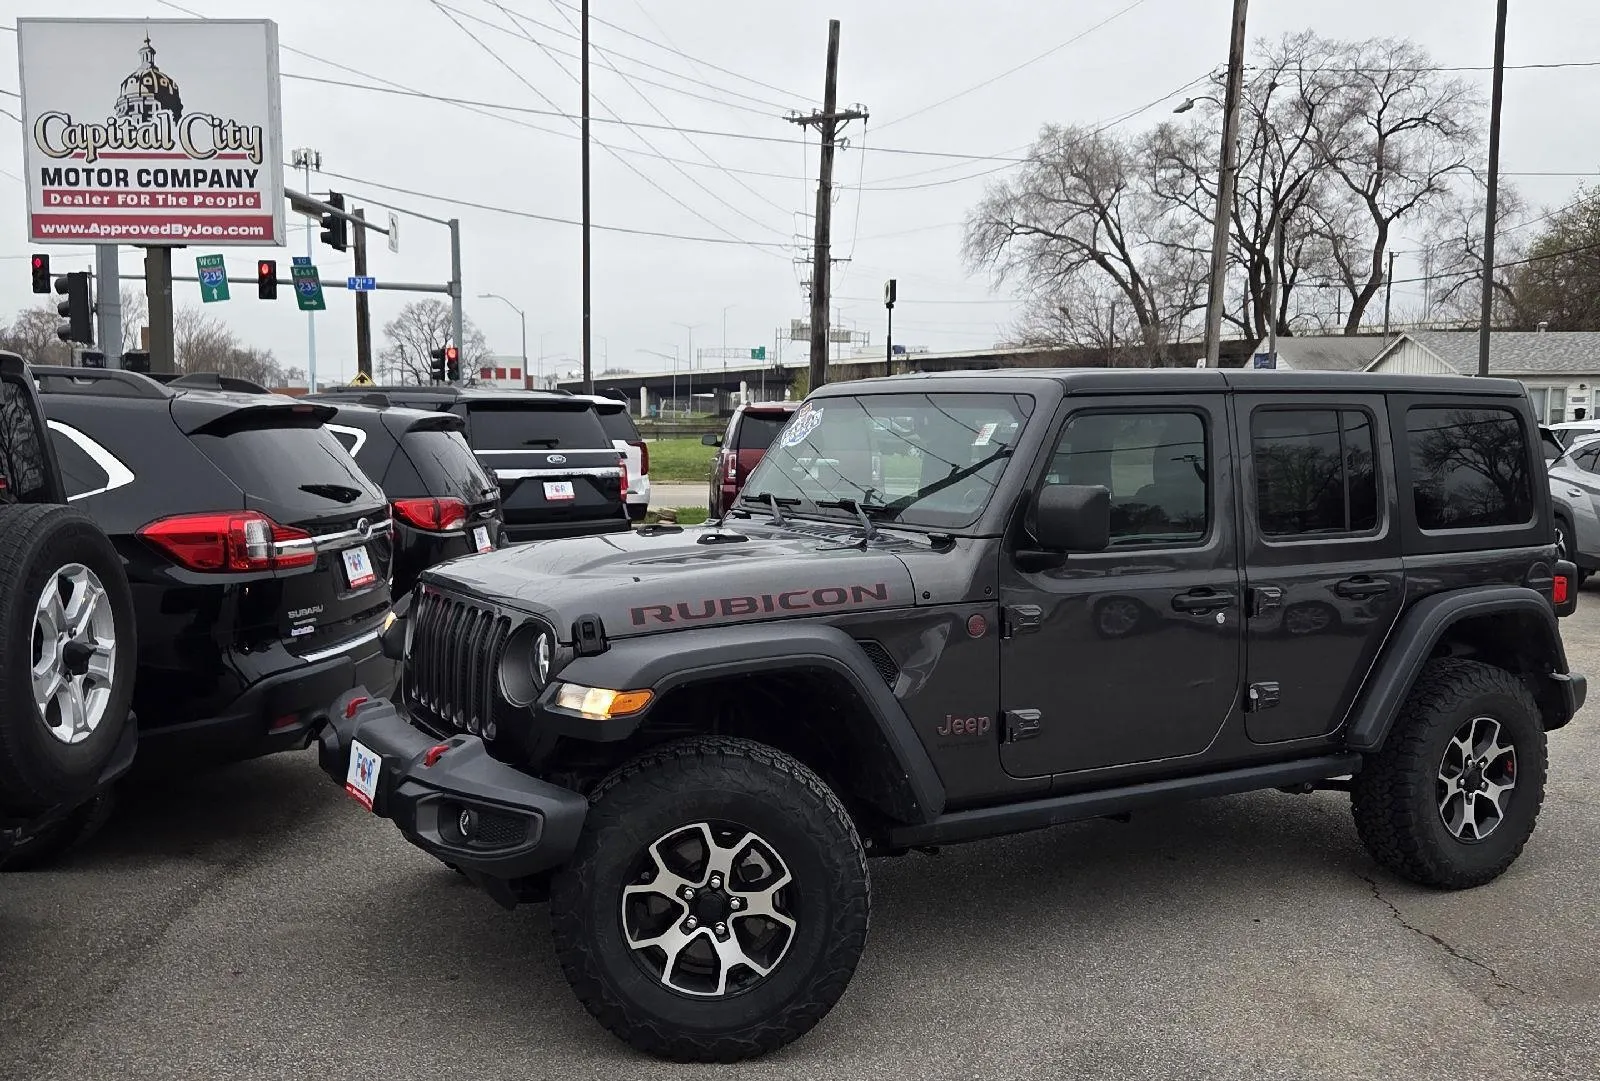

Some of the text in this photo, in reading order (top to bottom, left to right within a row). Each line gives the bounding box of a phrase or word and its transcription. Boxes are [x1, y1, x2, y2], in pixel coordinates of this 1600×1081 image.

[34, 111, 263, 164] Capital City
[41, 167, 259, 188] MOTOR COMPANY
[50, 193, 255, 208] Dealer FOR The People
[41, 222, 264, 237] www.ApprovedByJoe.com
[203, 271, 223, 282] 235
[299, 282, 318, 292] 235
[288, 604, 324, 618] SUBARU
[630, 583, 888, 625] RUBICON
[937, 714, 991, 737] Jeep
